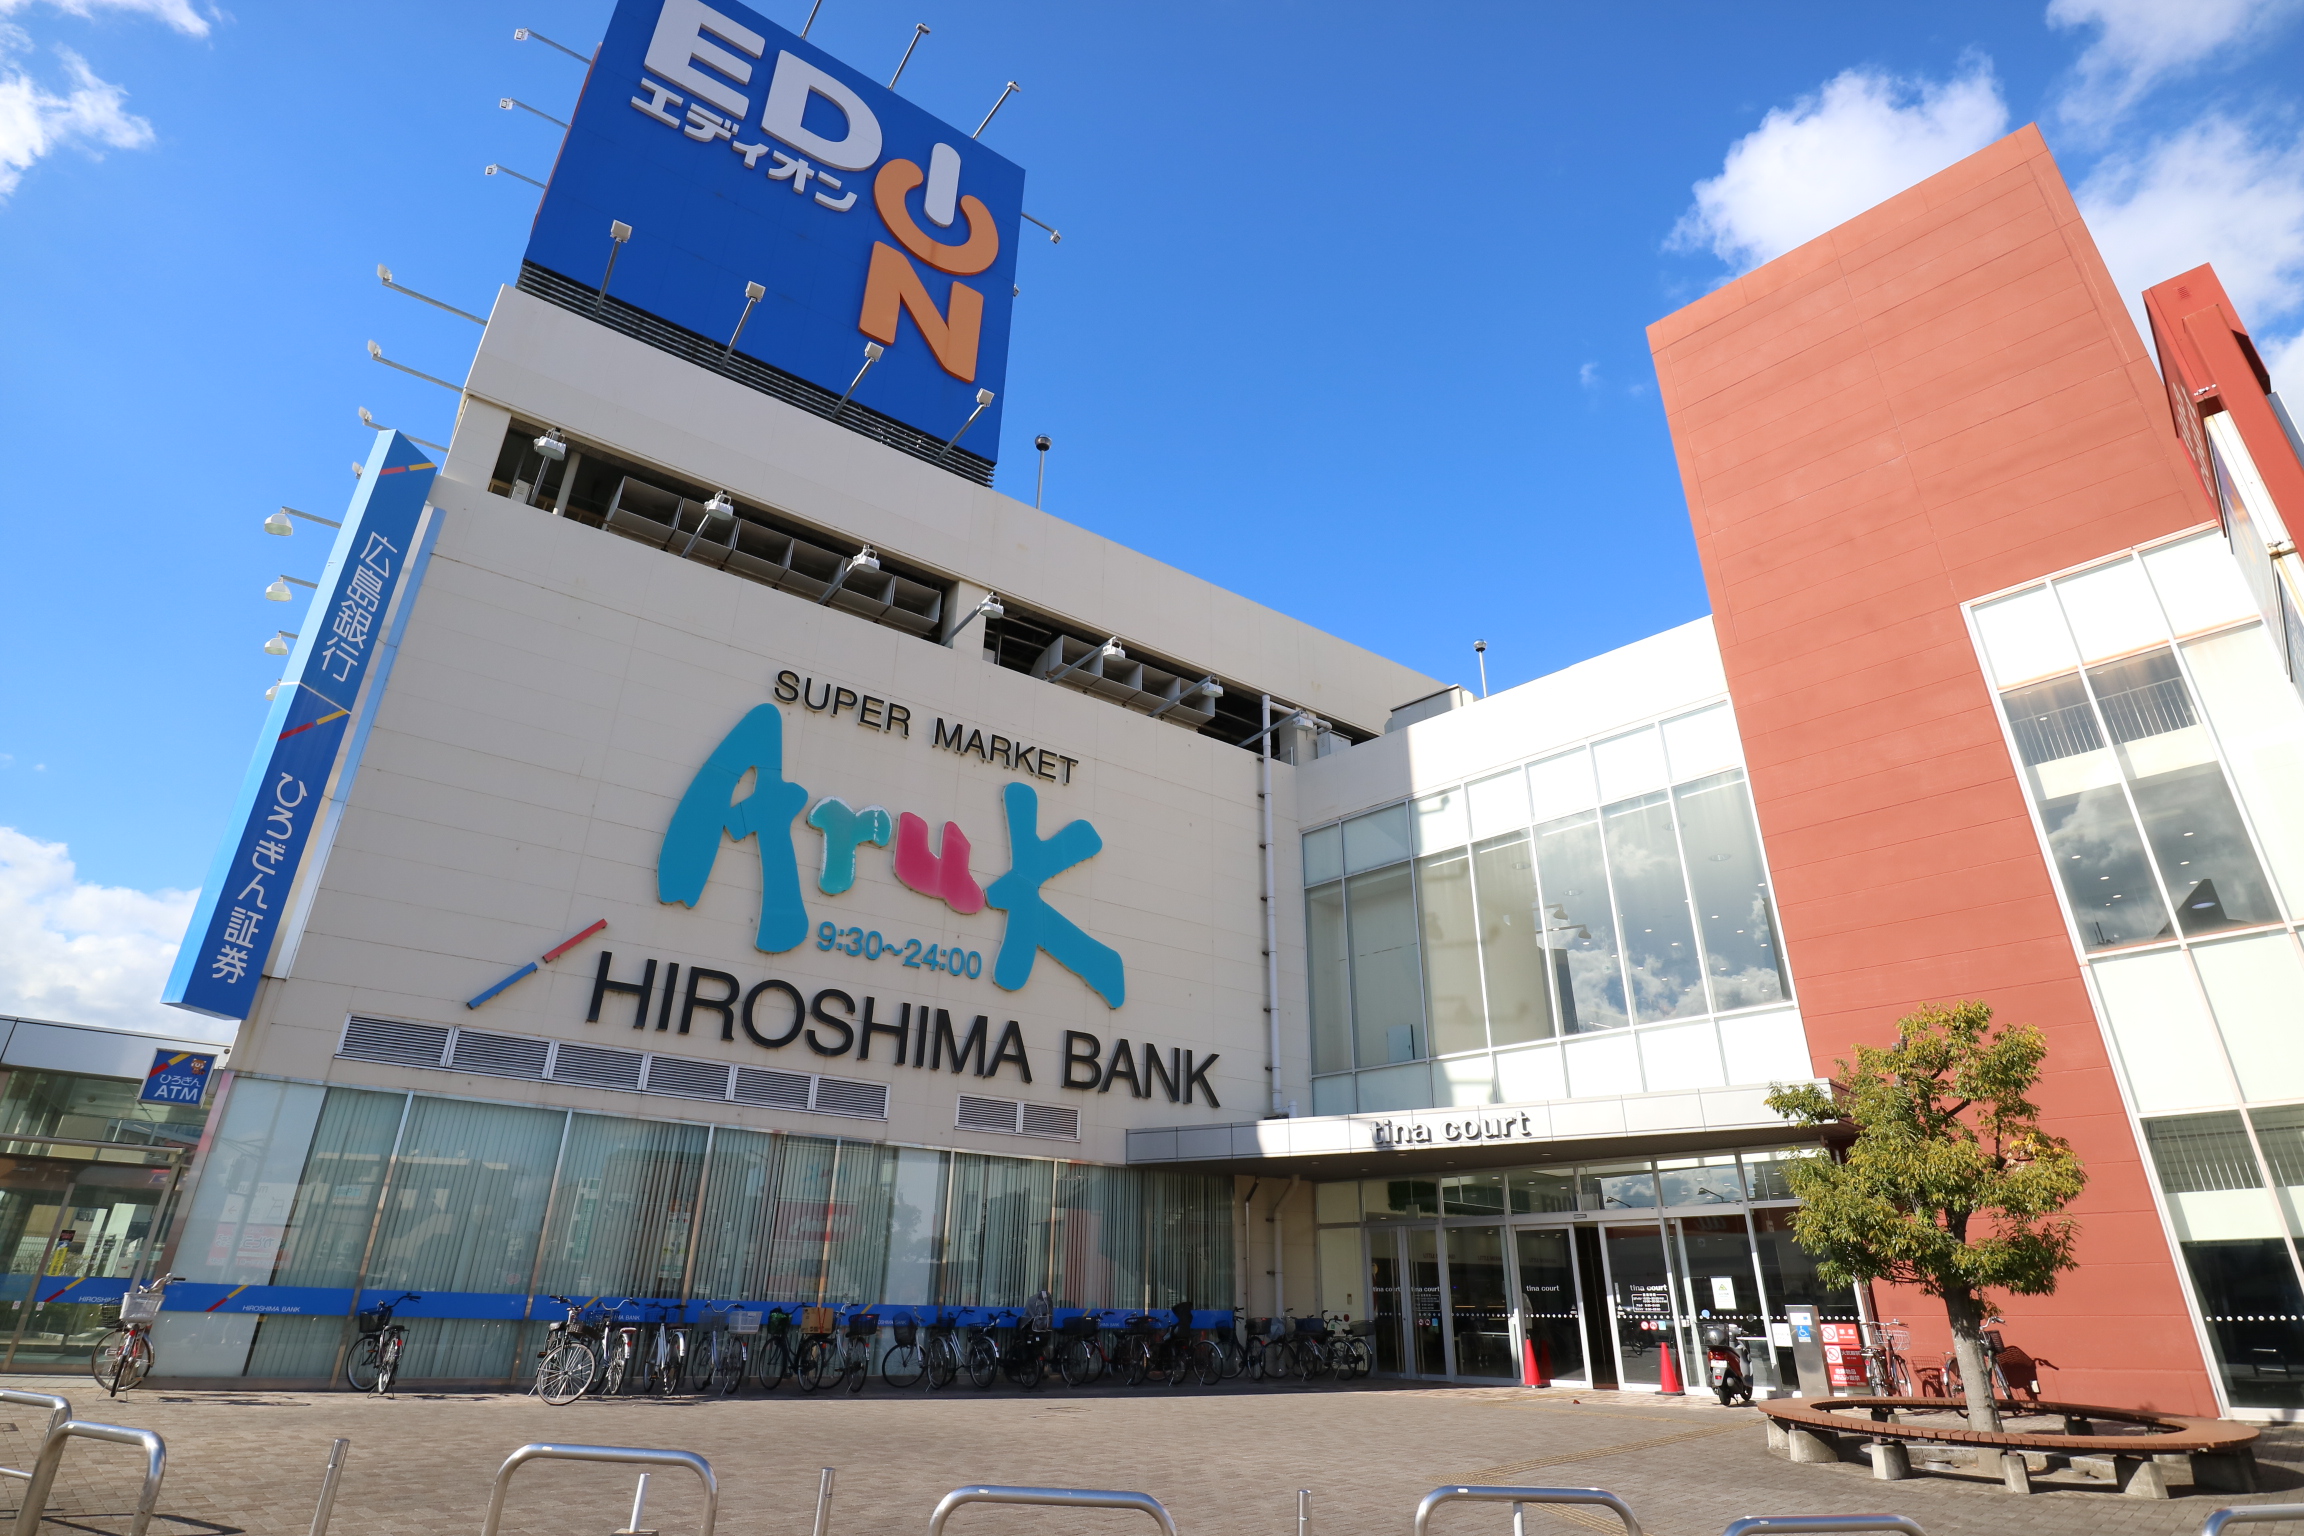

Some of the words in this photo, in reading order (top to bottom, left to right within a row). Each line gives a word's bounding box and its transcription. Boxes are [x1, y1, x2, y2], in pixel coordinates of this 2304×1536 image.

[631, 77, 857, 212] エディオン
[322, 530, 399, 682] 広島銀行
[774, 670, 912, 739] SUPER
[933, 717, 1080, 785] MARKET
[211, 771, 309, 984] ひろぎん証券
[160, 1074, 201, 1088] ひろぎん
[585, 950, 1033, 1084] HIROSHIMA
[1061, 1029, 1221, 1108] BANK
[154, 1085, 199, 1101] ATM
[1369, 1118, 1432, 1145] tina
[1440, 1110, 1533, 1141] court
